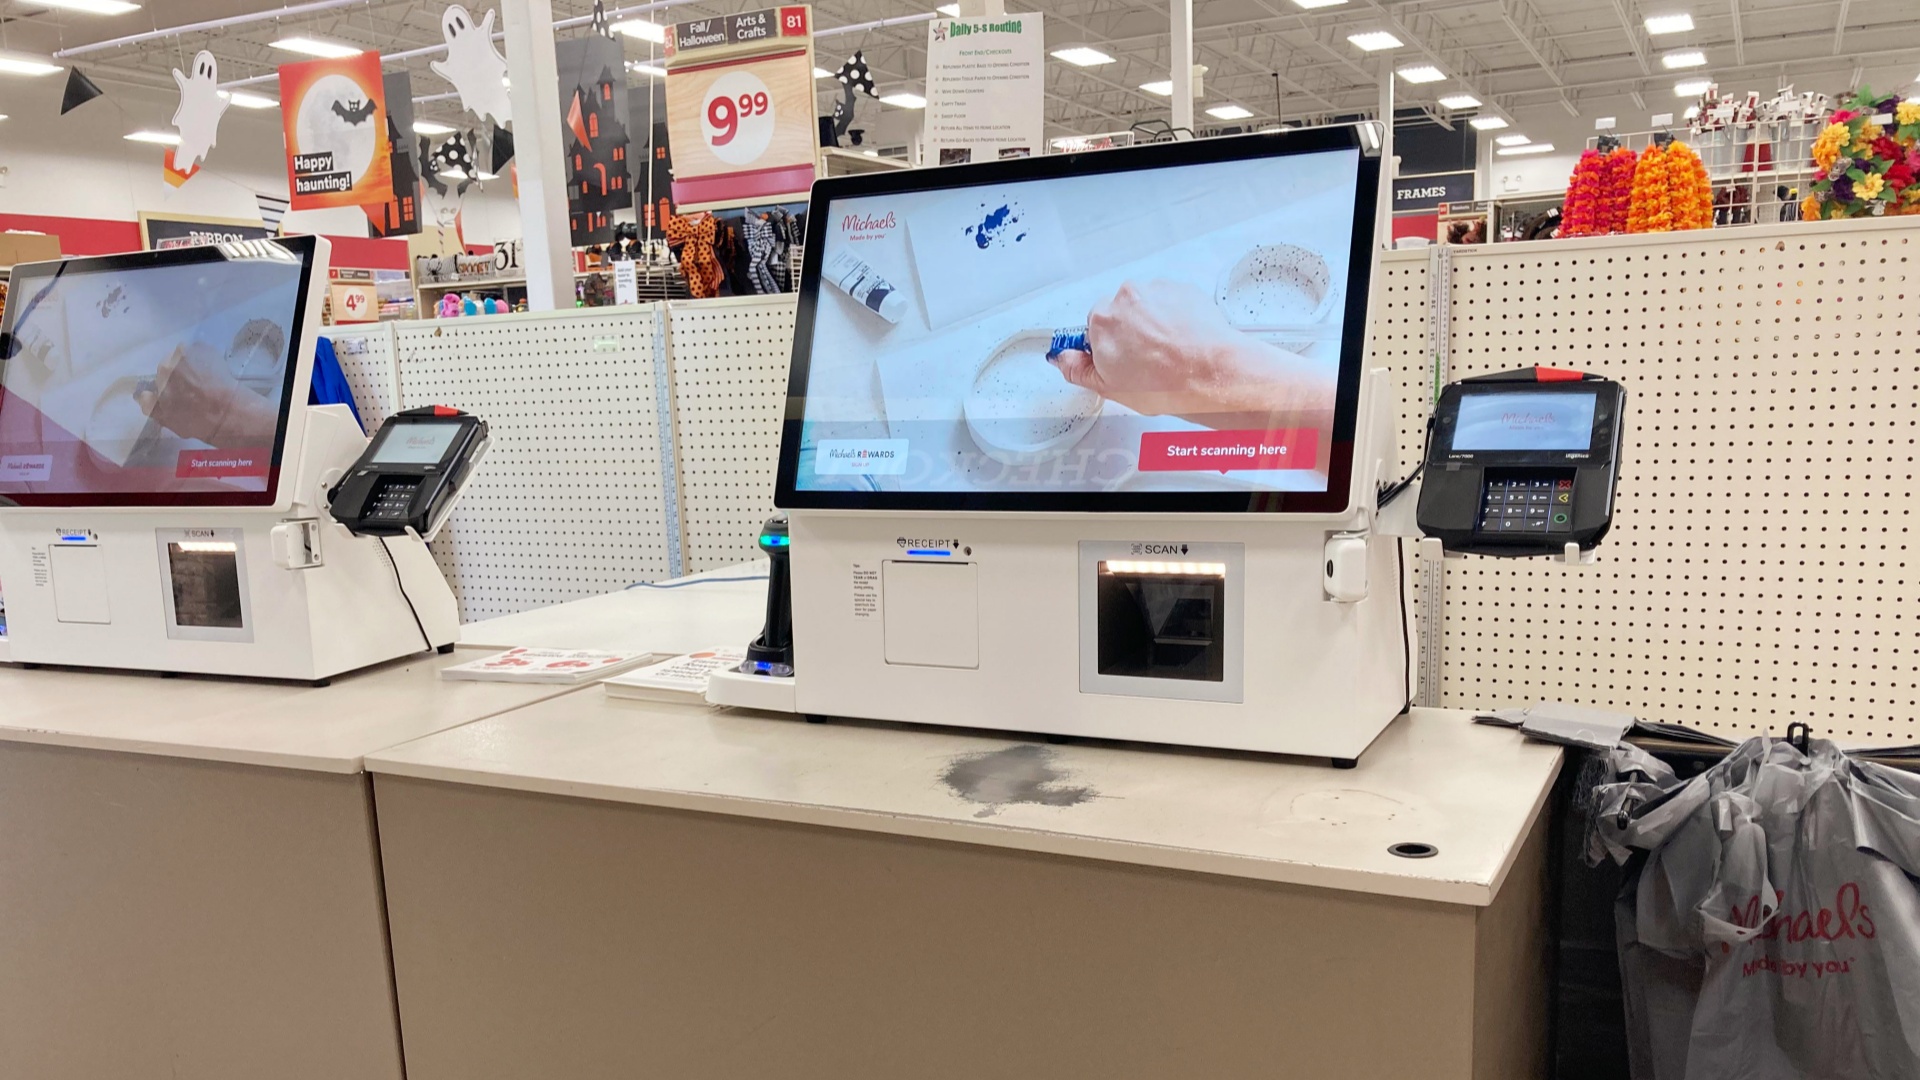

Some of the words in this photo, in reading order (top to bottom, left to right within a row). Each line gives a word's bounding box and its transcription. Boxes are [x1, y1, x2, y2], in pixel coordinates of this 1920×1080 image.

[690, 20, 712, 34] Fall/
[736, 15, 756, 28] Arts
[758, 14, 766, 24] &
[786, 15, 802, 28] 81
[736, 26, 767, 40] Crafts
[950, 21, 972, 38] Daily
[989, 20, 1022, 34] Routine
[679, 32, 725, 48] Halloween
[294, 156, 332, 172] Happy
[296, 173, 350, 192] haunting!
[1396, 186, 1446, 200] FRAMES
[842, 211, 896, 232] Michaels
[494, 240, 519, 271] 31
[830, 448, 856, 458] Michaels
[1167, 445, 1198, 456] Start
[1201, 444, 1256, 458] scanning
[1259, 444, 1287, 455] here
[191, 458, 208, 468] Start
[208, 458, 237, 469] scanning
[238, 458, 253, 467] here
[908, 539, 950, 548] RECEIPT
[1145, 544, 1178, 554] SCAN
